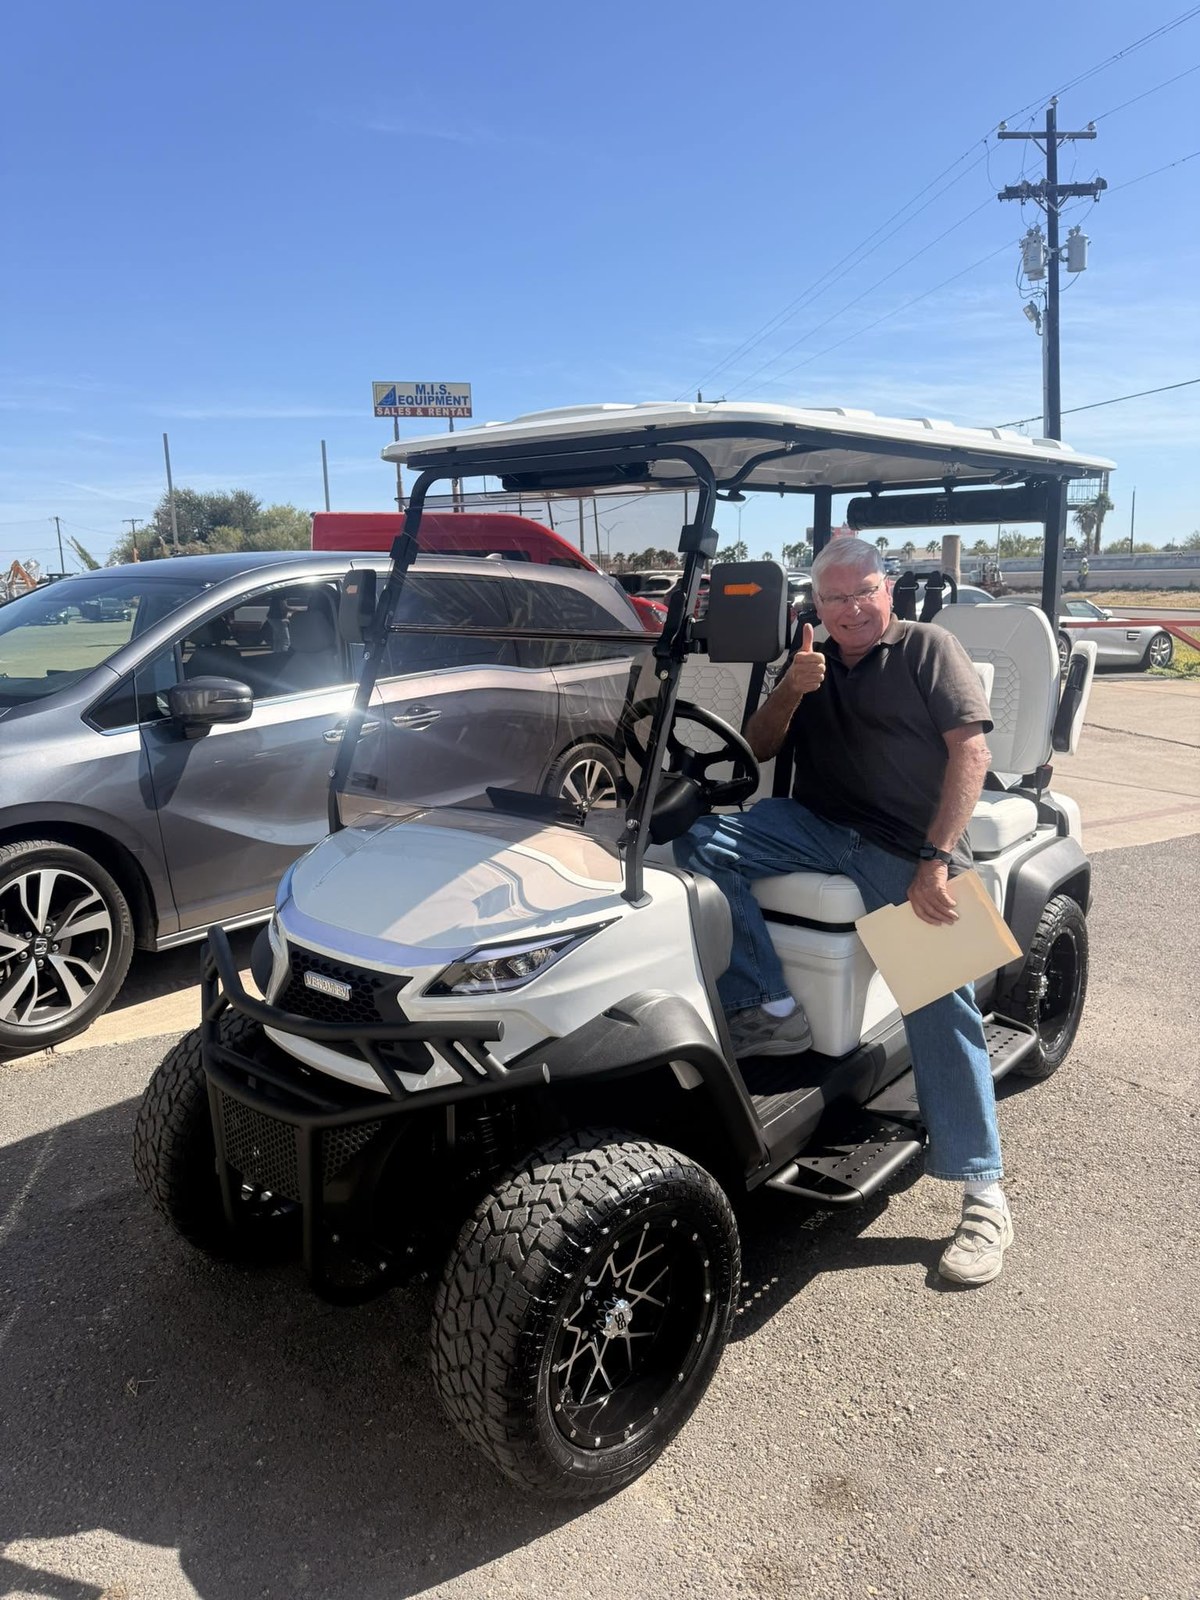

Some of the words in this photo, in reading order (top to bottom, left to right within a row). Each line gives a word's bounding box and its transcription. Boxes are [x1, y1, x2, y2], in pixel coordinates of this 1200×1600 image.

[415, 384, 451, 395] M.I.S.
[398, 395, 469, 406] EQUIPMENT
[376, 407, 411, 416] SALES
[416, 408, 423, 416] &
[428, 407, 470, 416] RENTAL
